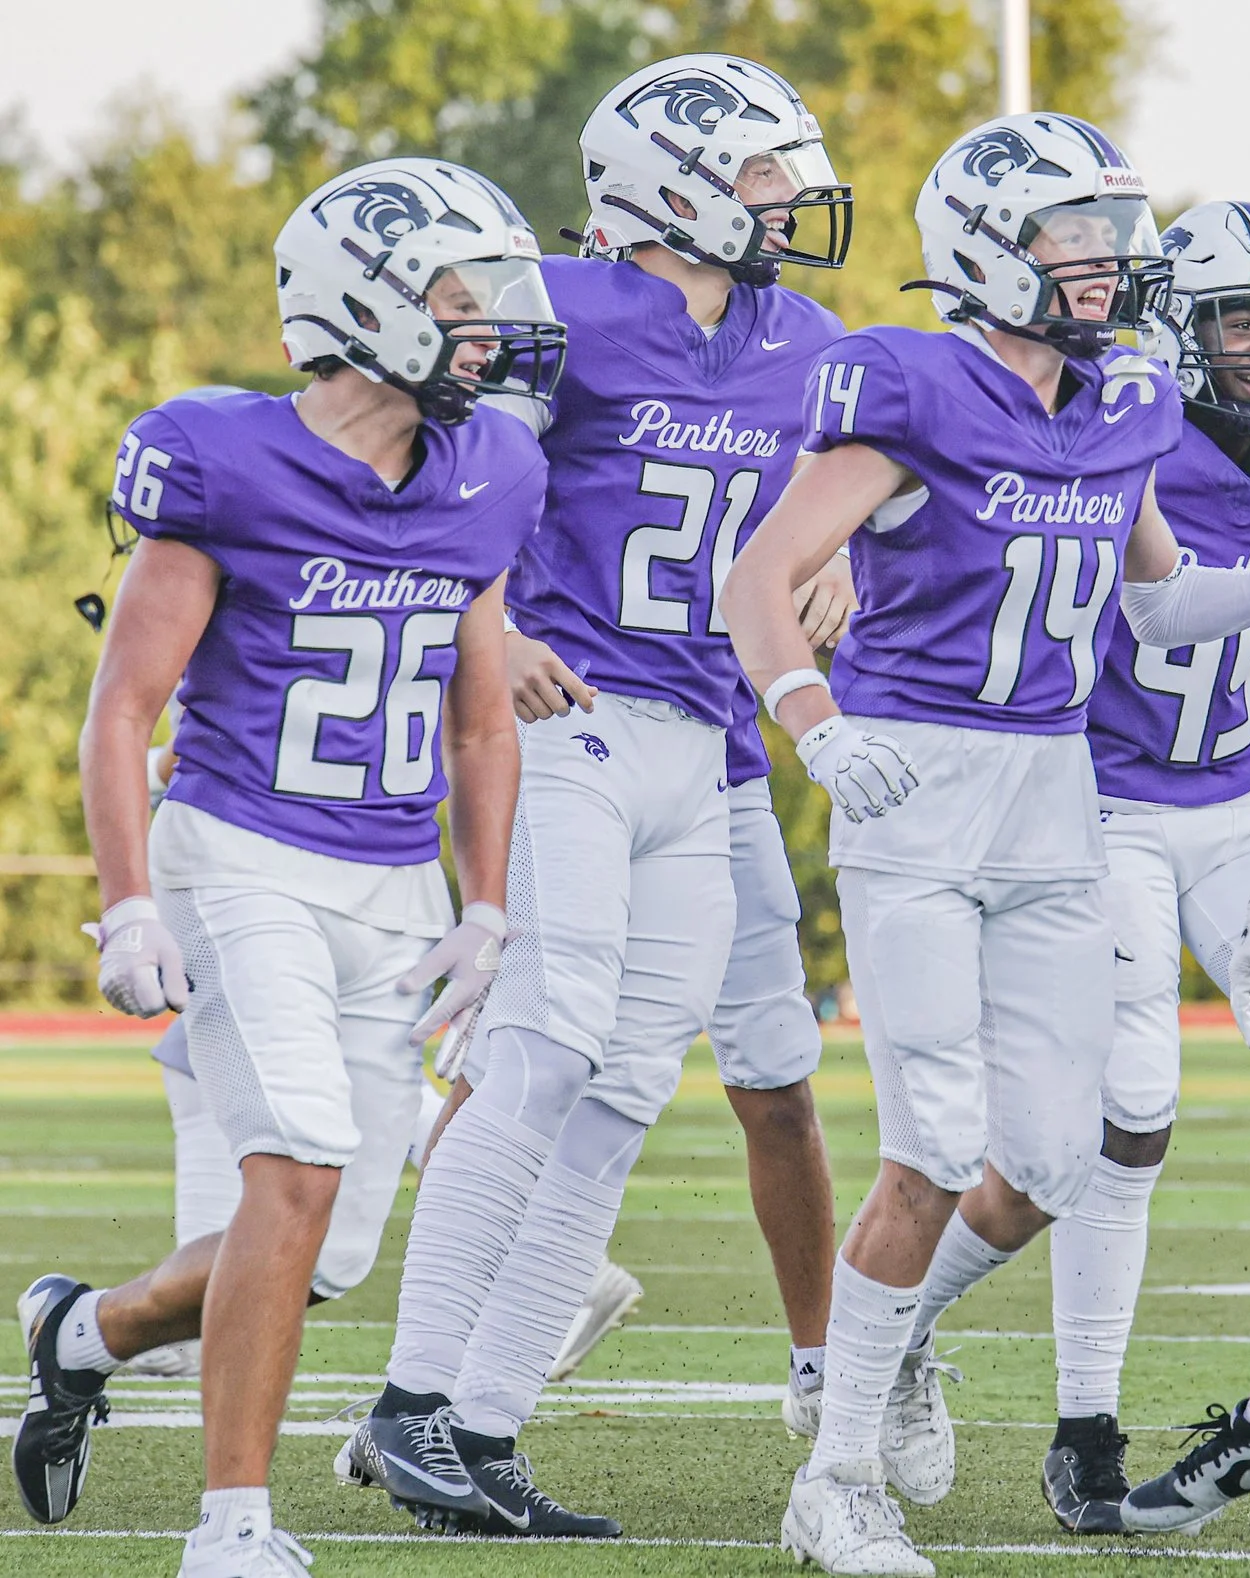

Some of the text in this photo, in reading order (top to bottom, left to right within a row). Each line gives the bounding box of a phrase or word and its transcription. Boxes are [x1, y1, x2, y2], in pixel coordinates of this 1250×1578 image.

[619, 399, 781, 459] Panthers
[815, 363, 866, 434] 14
[112, 431, 173, 521] 26
[975, 471, 1126, 525] Panthers
[289, 556, 470, 610] Panthers
[618, 457, 762, 638] 21
[977, 532, 1118, 708] 14
[273, 610, 461, 800] 26
